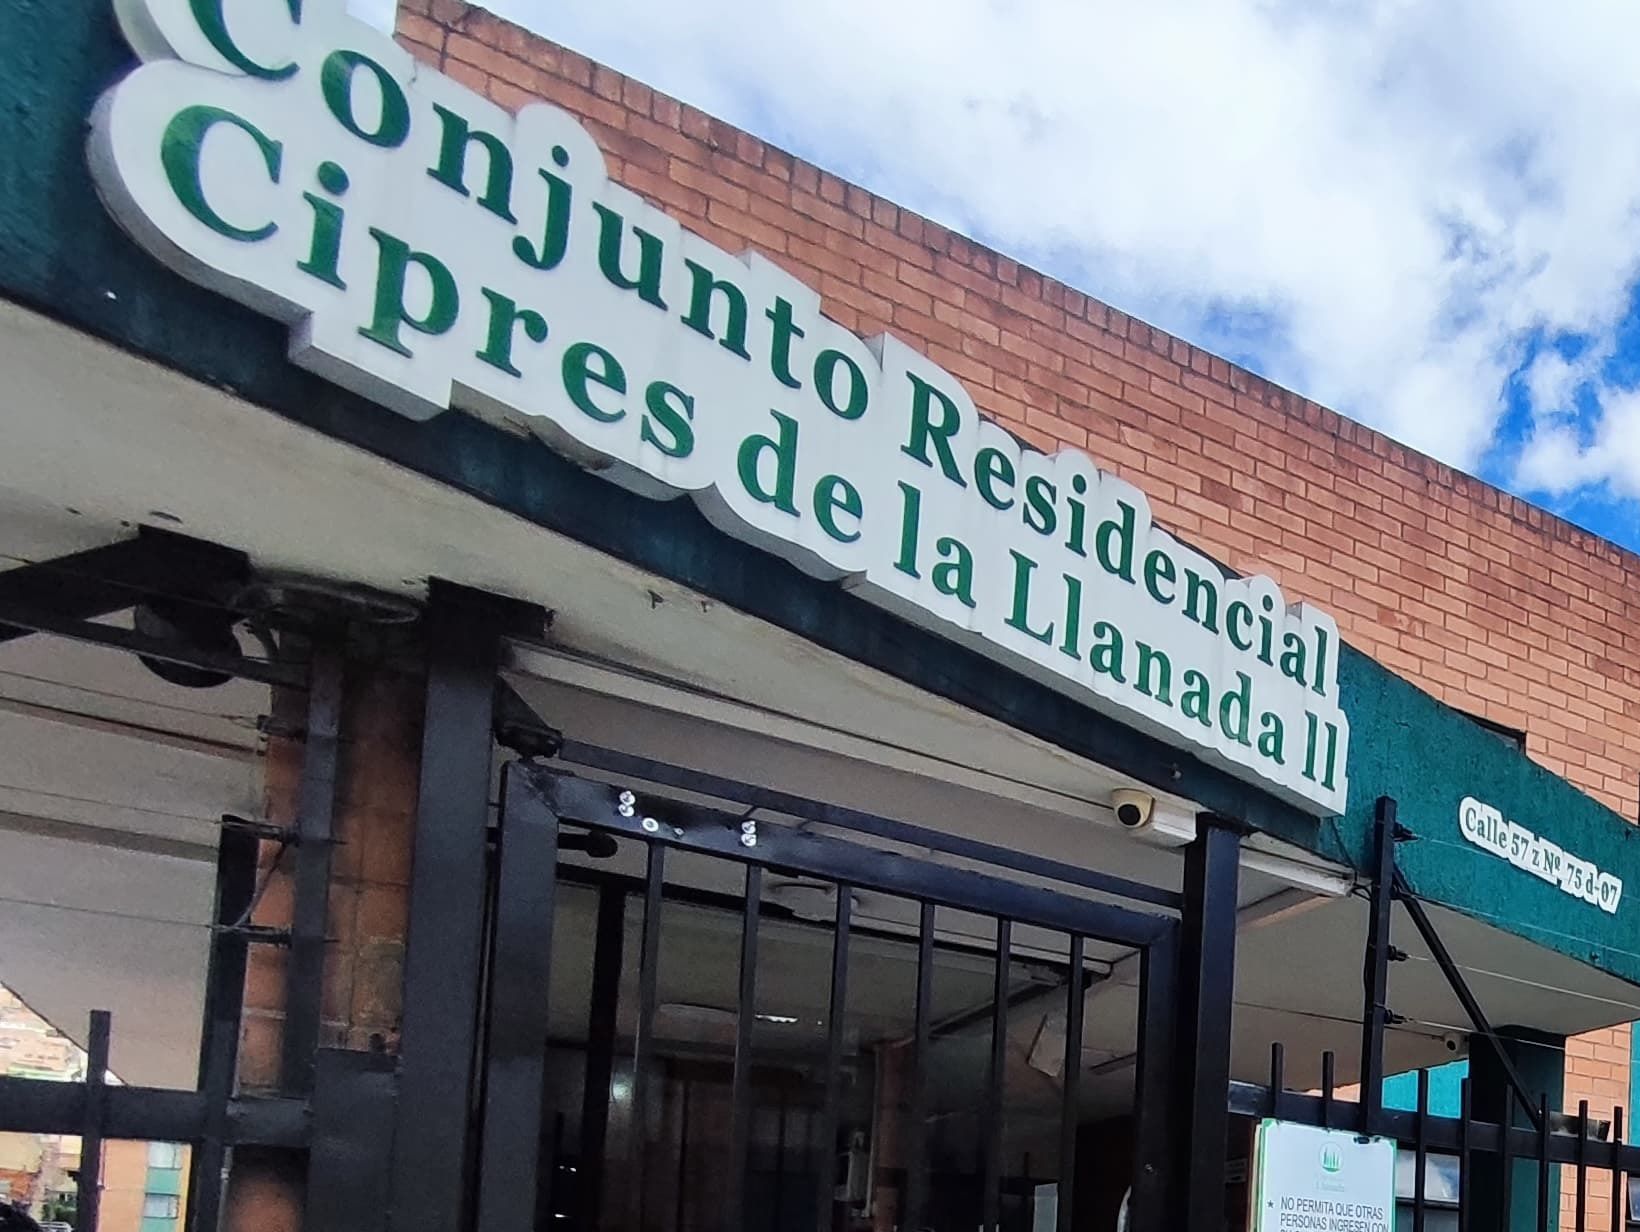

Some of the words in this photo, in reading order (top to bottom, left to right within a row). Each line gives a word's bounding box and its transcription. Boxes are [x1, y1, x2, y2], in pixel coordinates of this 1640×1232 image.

[189, 0, 869, 421] Conjunto
[902, 373, 1328, 697] Residencial
[161, 105, 695, 459] Cipres
[737, 410, 863, 544] de
[894, 481, 976, 609] la
[1004, 550, 1285, 766] Llanada
[1465, 807, 1508, 849] Calle
[1511, 832, 1529, 861] 57
[1532, 848, 1540, 866] z
[1566, 863, 1582, 890] 75
[1280, 1195, 1295, 1210] NO
[1296, 1198, 1334, 1214] PERMITA
[1335, 1202, 1354, 1217] QUE
[1355, 1204, 1384, 1220] OTRAS
[1280, 1212, 1327, 1230] PERSONAS
